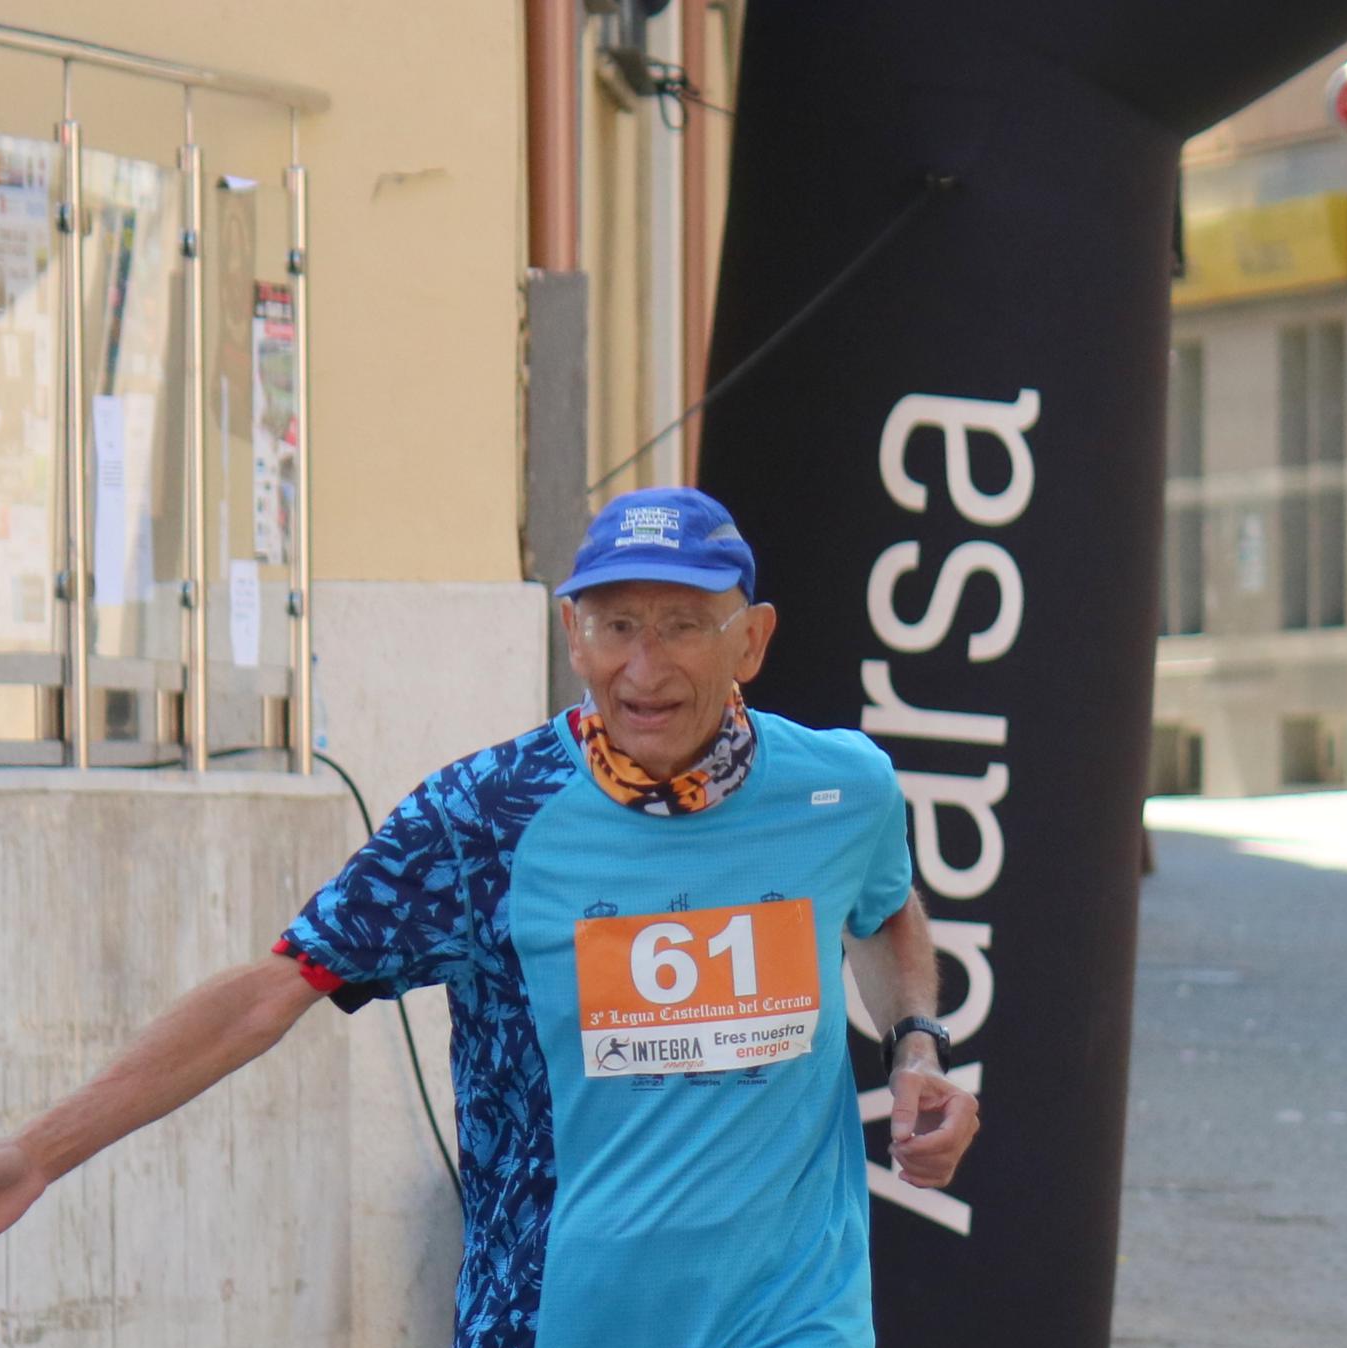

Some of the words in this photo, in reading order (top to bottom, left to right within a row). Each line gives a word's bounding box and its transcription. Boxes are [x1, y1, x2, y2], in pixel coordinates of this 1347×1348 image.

[629, 913, 758, 1005] 61
[608, 1009, 655, 1025] Legua
[659, 1004, 734, 1021] Castellana
[738, 999, 758, 1014] del
[763, 994, 812, 1011] Cerrato
[714, 1031, 747, 1045] Eres
[752, 1024, 805, 1042] nuestra
[632, 1037, 703, 1062] INTEGRA
